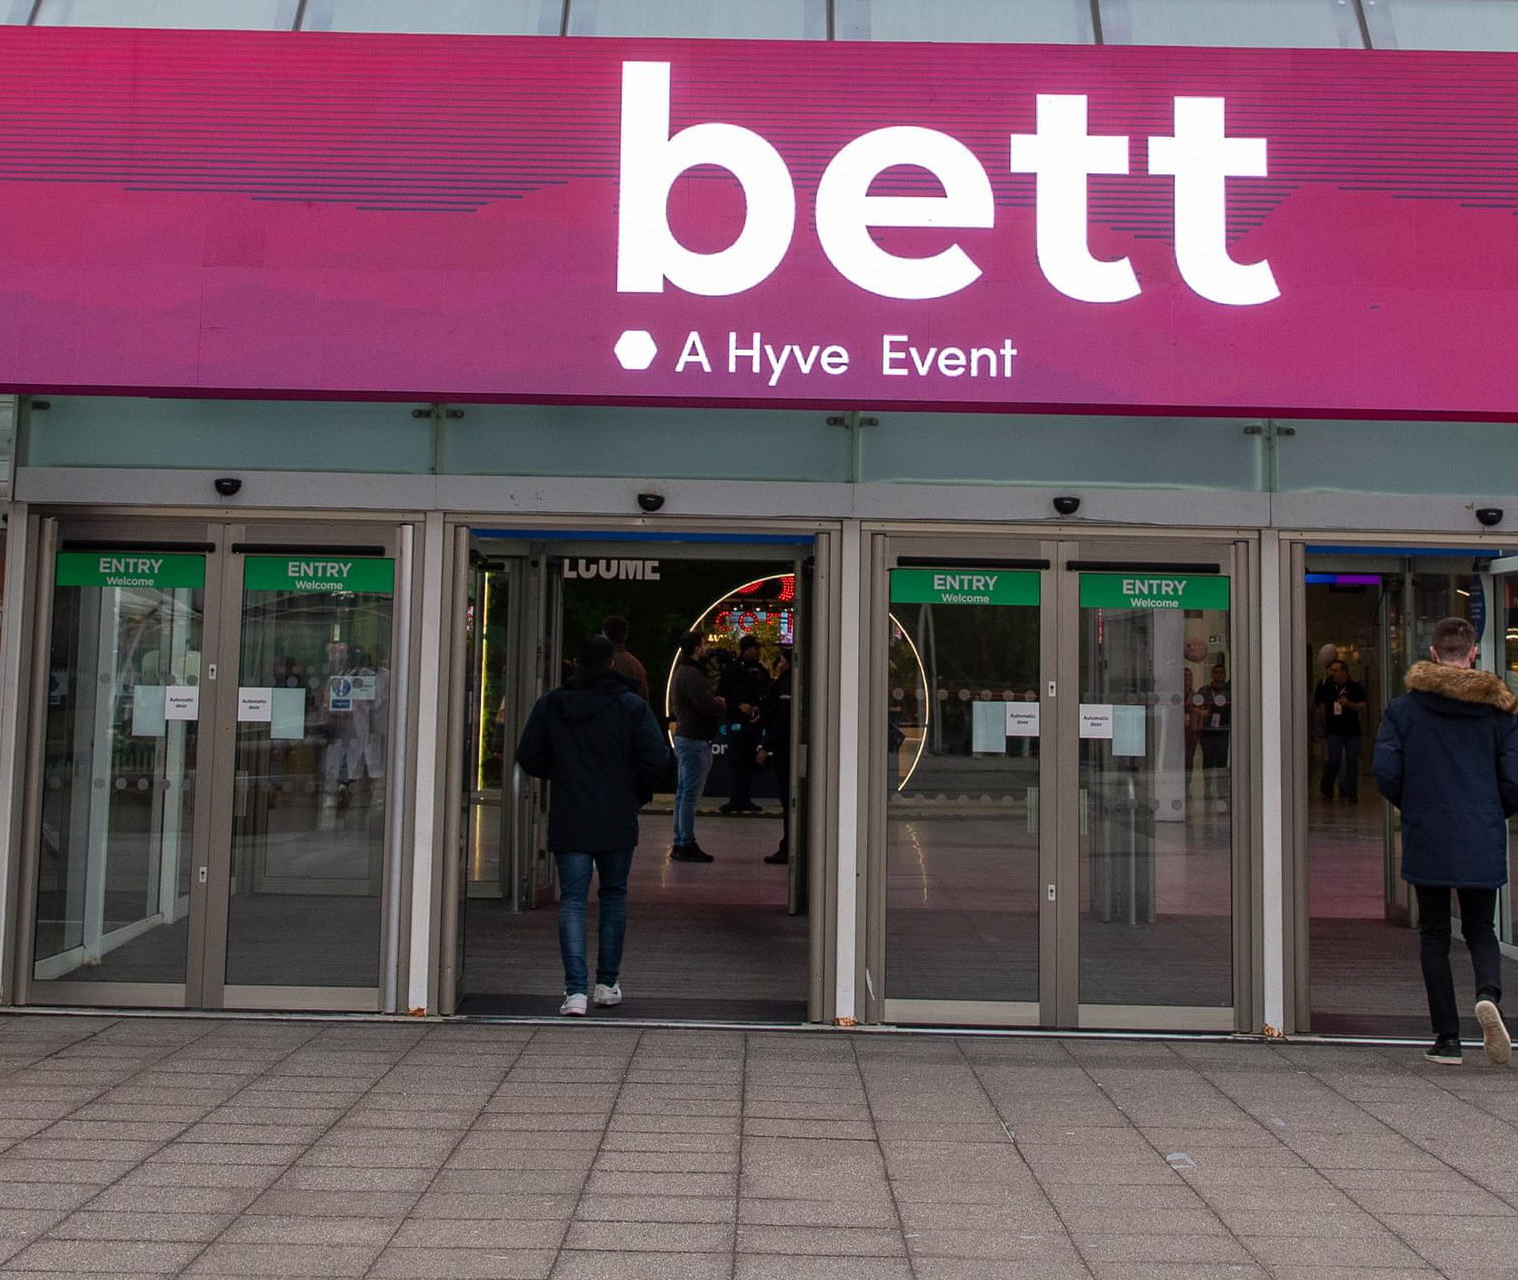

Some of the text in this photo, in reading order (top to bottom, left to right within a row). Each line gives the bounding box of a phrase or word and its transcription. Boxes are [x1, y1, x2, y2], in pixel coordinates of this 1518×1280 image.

[617, 61, 1281, 305] bett
[675, 331, 1018, 387] A Hyve Event
[99, 558, 163, 574] ENTRY
[288, 561, 352, 578] ENTRY
[106, 576, 154, 586] Welcome
[295, 580, 343, 590] Welcome
[933, 574, 998, 591] ENTRY
[1122, 579, 1187, 596] ENTRY
[941, 593, 990, 603] Welcome
[1130, 597, 1179, 607] Welcome
